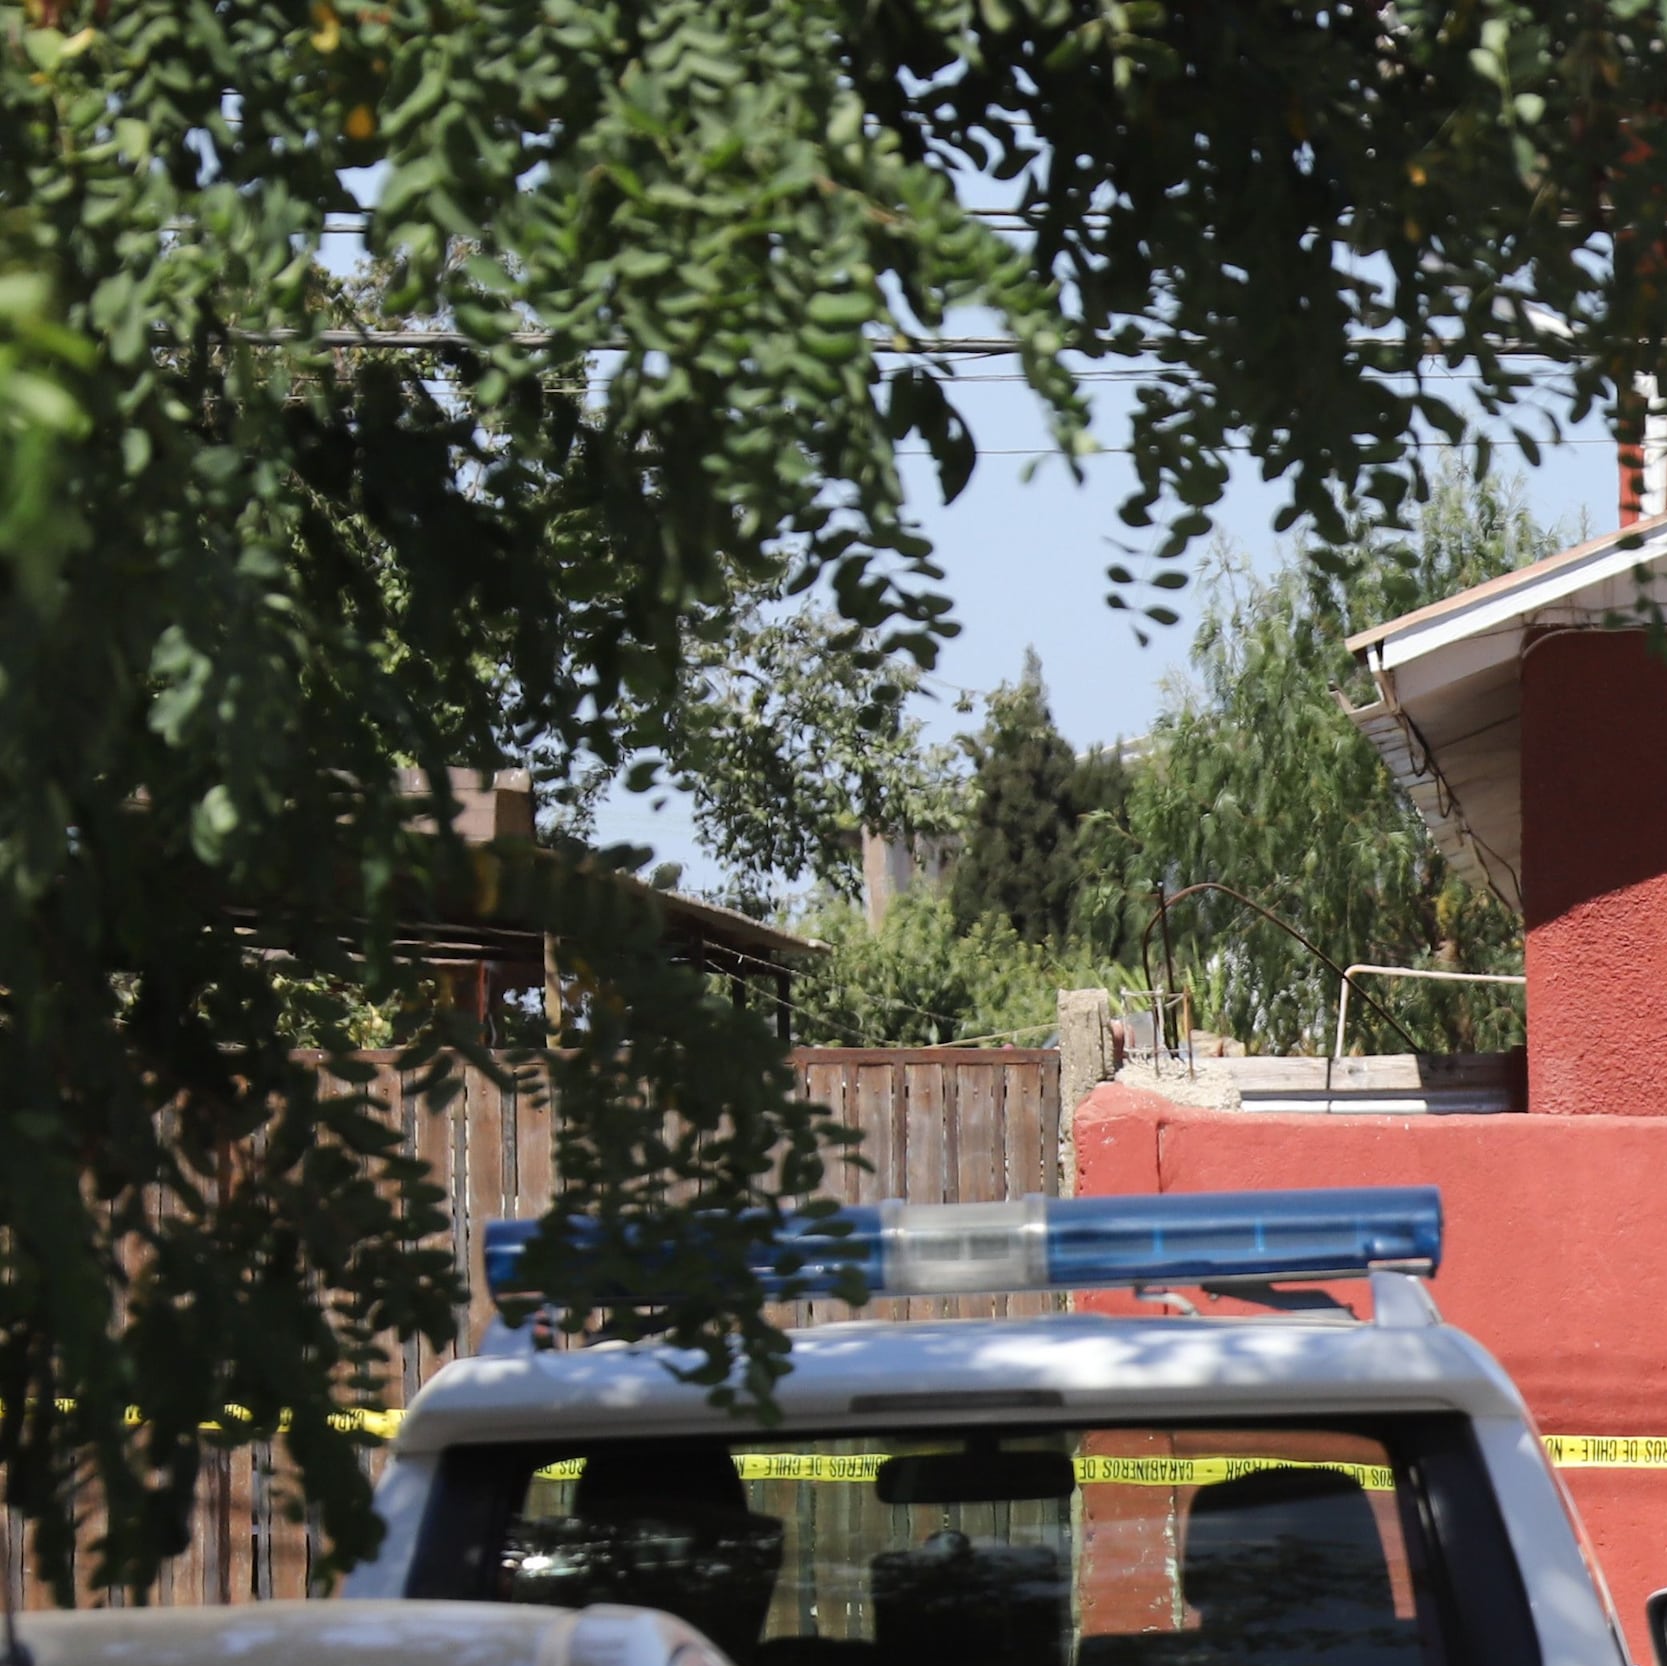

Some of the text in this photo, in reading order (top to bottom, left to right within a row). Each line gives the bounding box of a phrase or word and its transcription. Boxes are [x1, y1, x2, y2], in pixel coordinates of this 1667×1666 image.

[1581, 1439, 1618, 1463] CHILE
[1623, 1440, 1638, 1464] DE
[764, 1456, 800, 1476] CHILE
[806, 1456, 822, 1476] DE
[1079, 1459, 1096, 1480] DE
[1102, 1458, 1194, 1480] CARABINEROS
